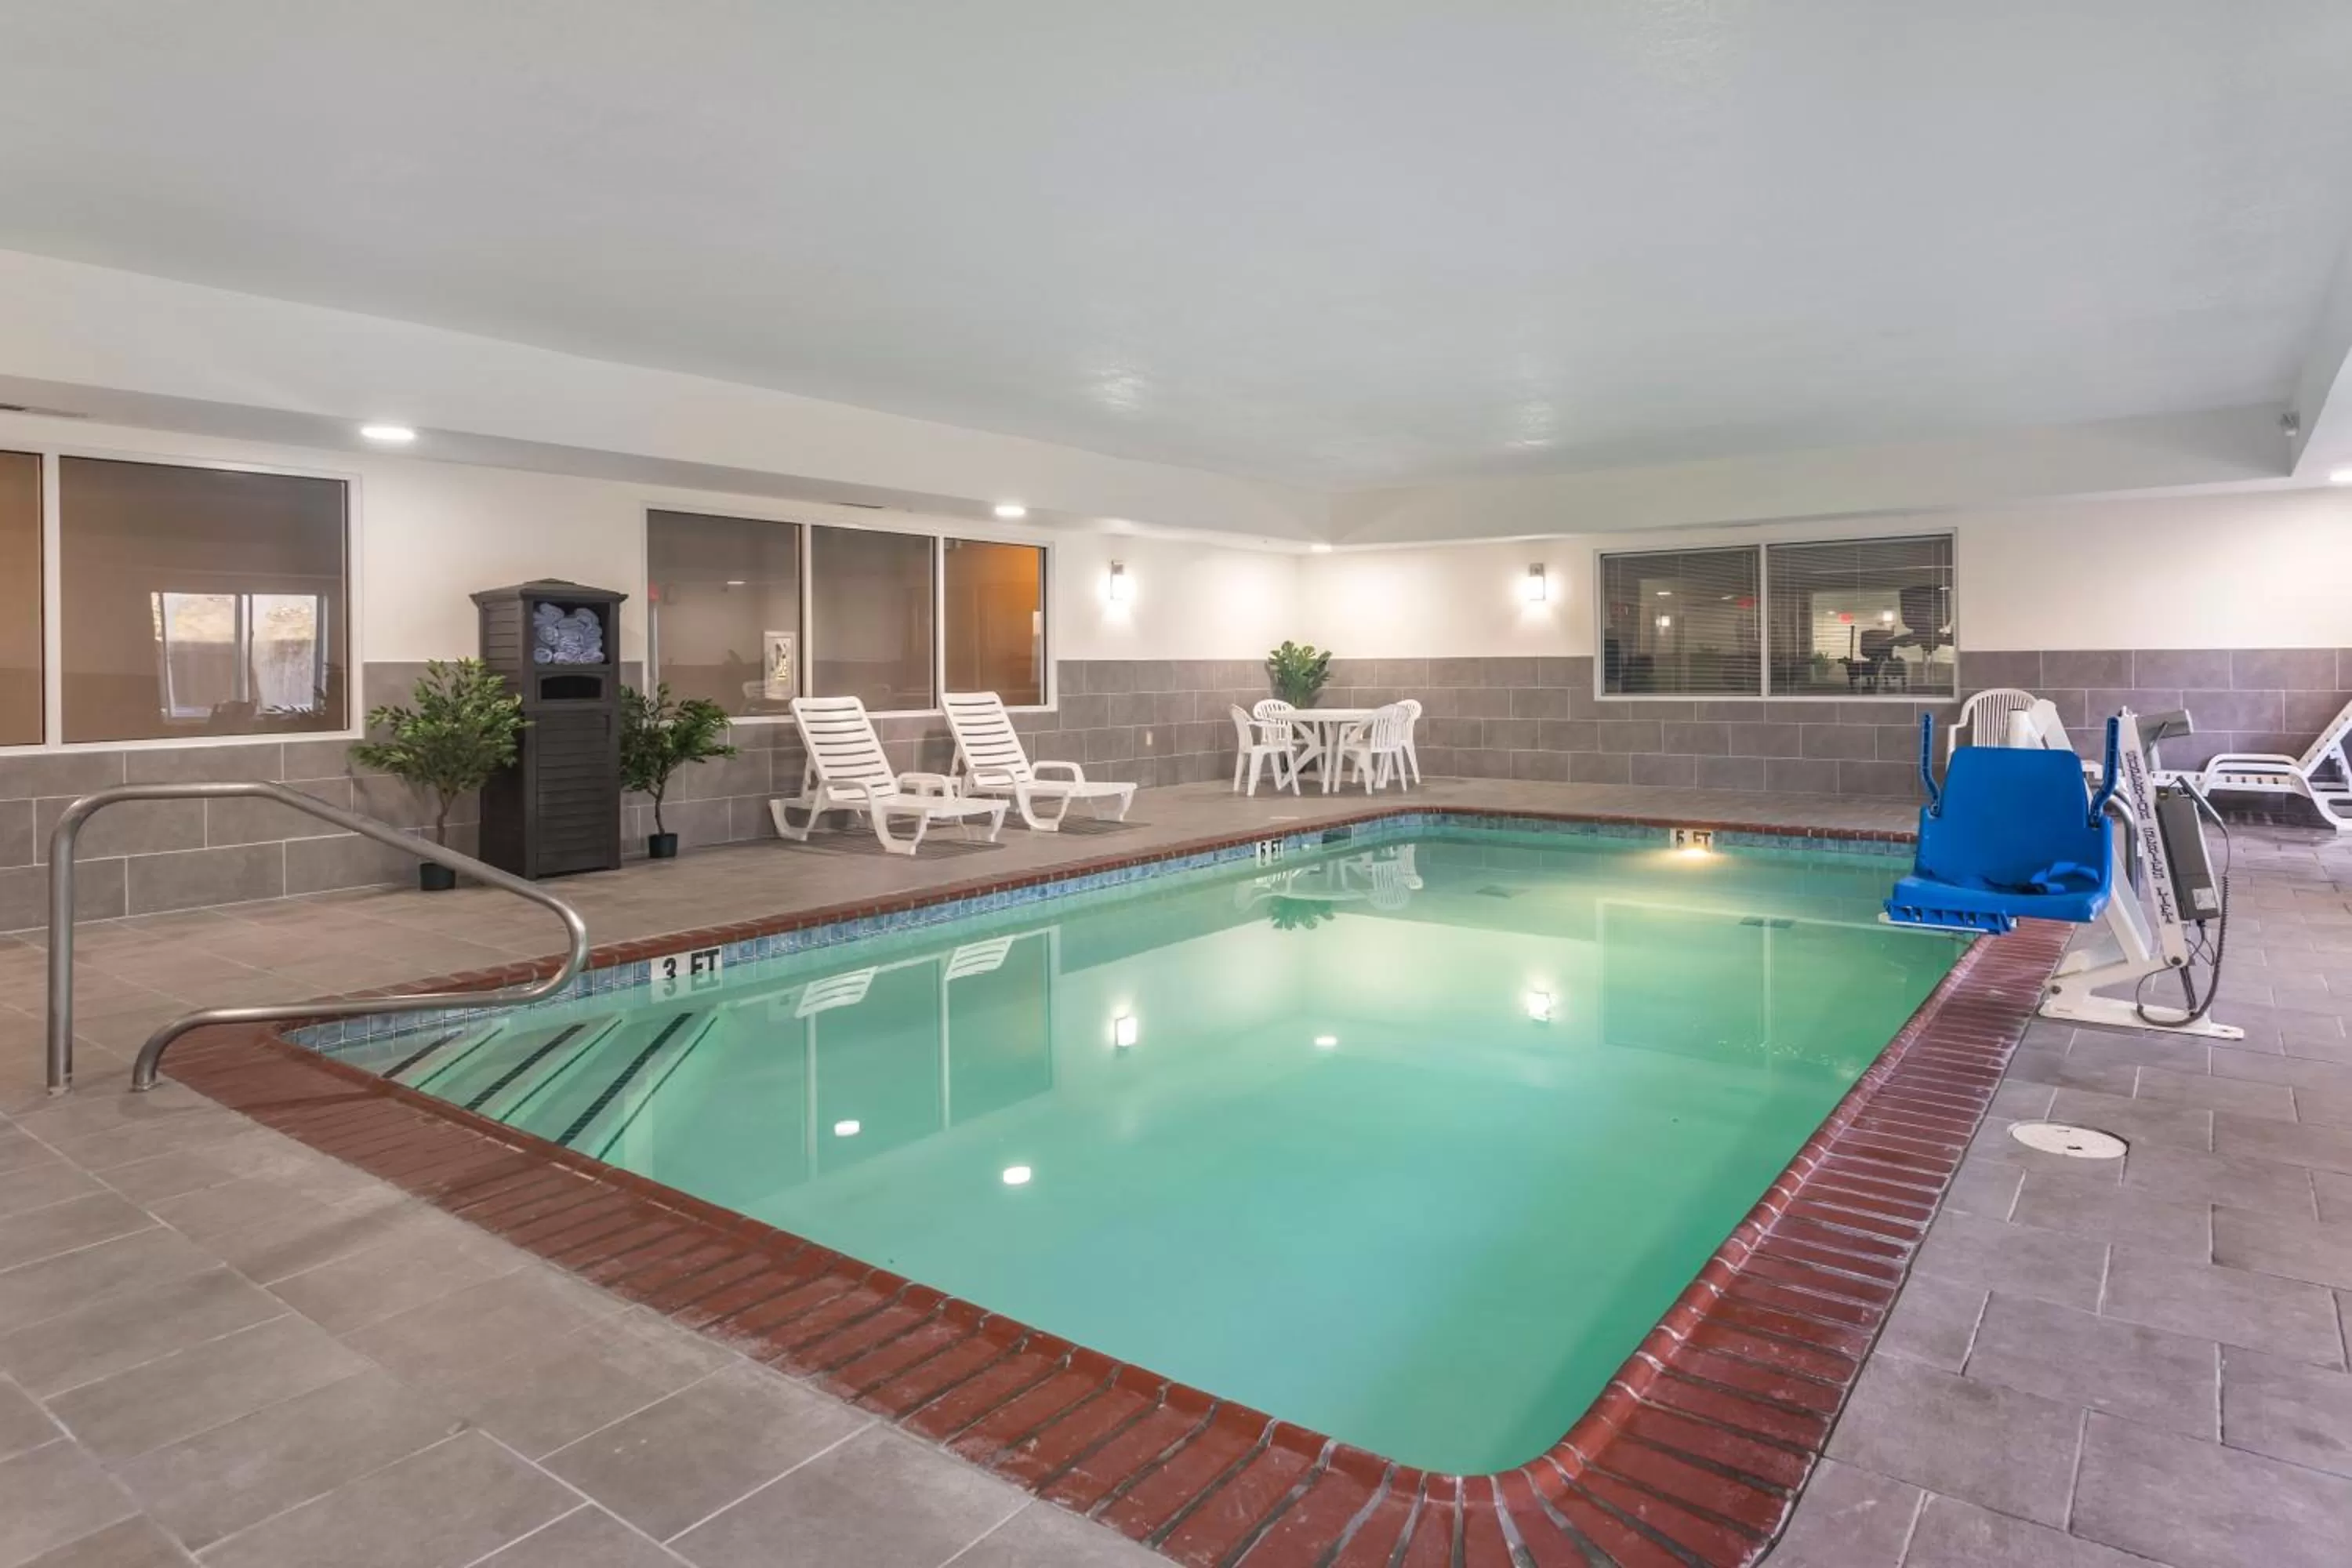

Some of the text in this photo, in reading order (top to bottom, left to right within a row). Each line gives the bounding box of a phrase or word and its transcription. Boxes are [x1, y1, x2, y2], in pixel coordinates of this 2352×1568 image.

[1271, 838, 1281, 854] FT
[1693, 831, 1711, 844] FT
[2143, 827, 2165, 879] SERIES
[2156, 887, 2174, 924] LIFT
[691, 948, 720, 975] FT
